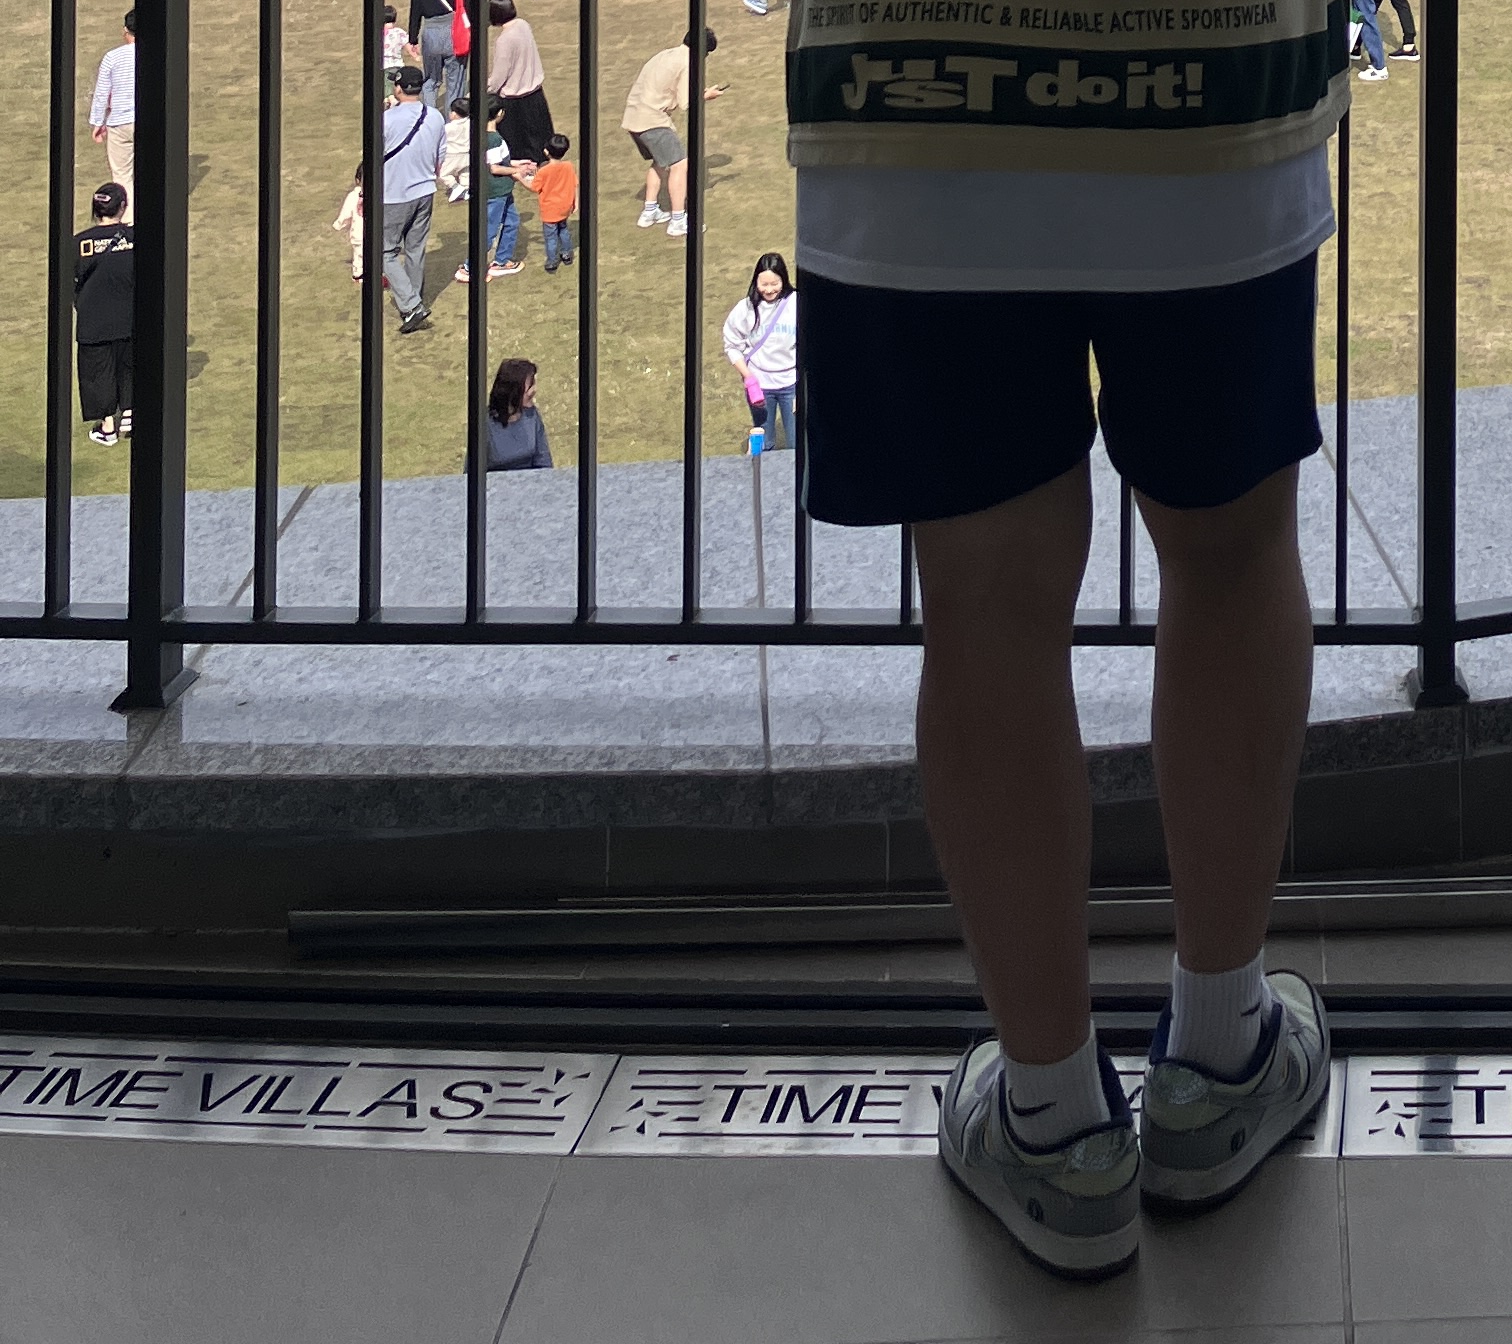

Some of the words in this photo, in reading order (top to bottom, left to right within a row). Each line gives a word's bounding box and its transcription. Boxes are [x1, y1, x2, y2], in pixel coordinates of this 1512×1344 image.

[859, 2, 879, 24] OF
[882, 1, 994, 25] AUTHENTIC
[1000, 5, 1012, 27] &
[1019, 7, 1103, 34] RELIABLE
[1110, 8, 1175, 34] ACTIVE
[1182, 2, 1277, 31] SPORTSWEAR
[1025, 59, 1119, 108] do
[1126, 60, 1203, 110] it!
[0, 1065, 183, 1109] TIME
[201, 1072, 494, 1120] VILLAS
[713, 1084, 910, 1124] TIME
